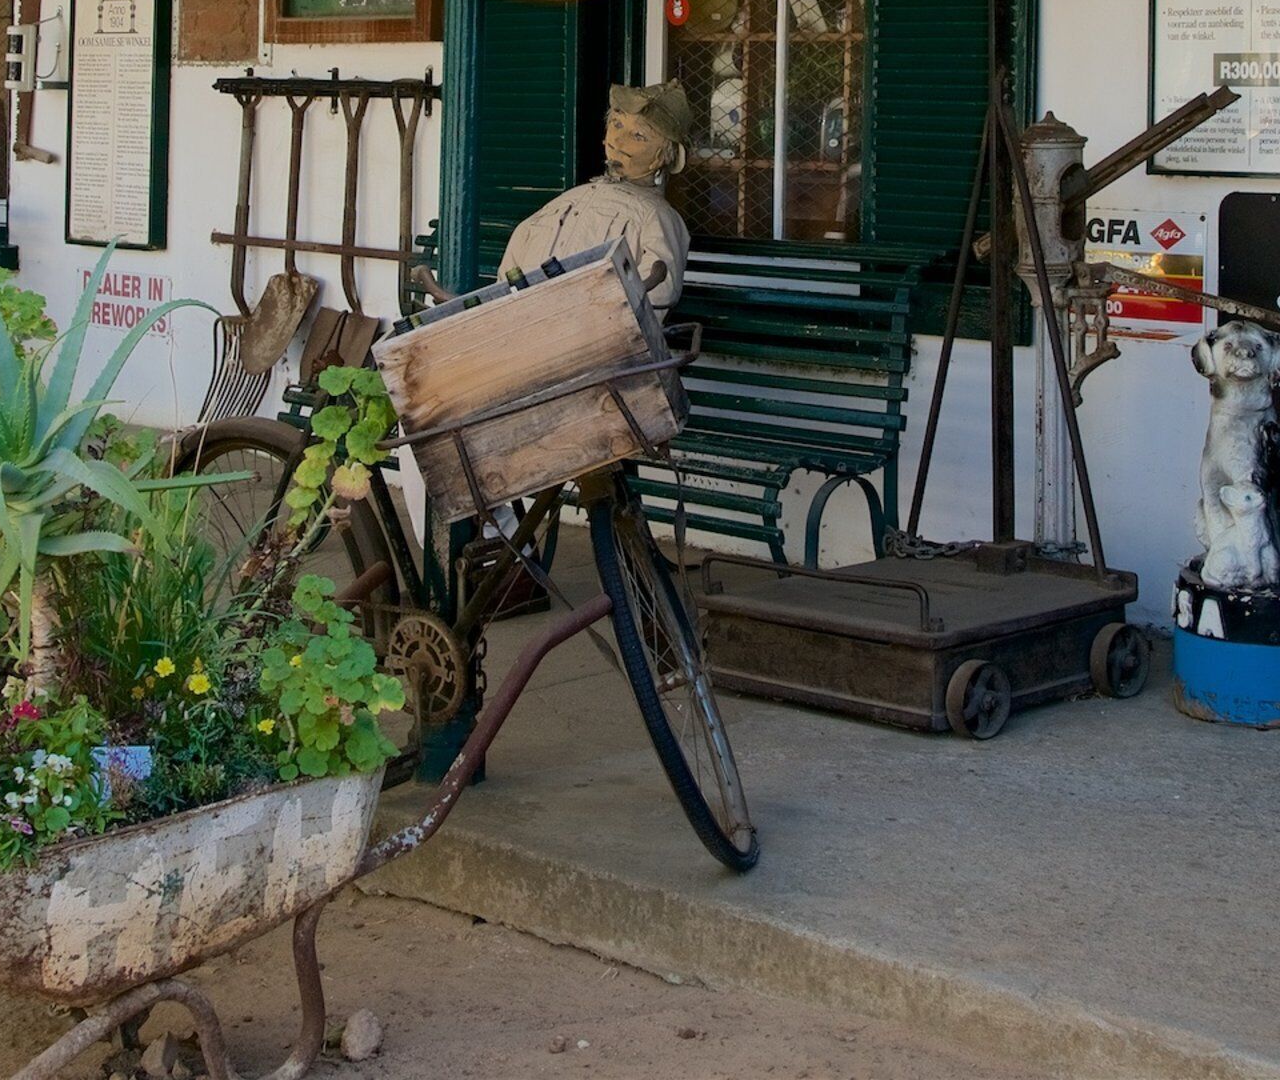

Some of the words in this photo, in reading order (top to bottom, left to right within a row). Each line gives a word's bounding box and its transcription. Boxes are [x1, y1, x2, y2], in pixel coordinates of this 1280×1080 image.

[1220, 61, 1280, 80] R300.00
[1086, 217, 1141, 245] GFA
[147, 278, 164, 300] IN
